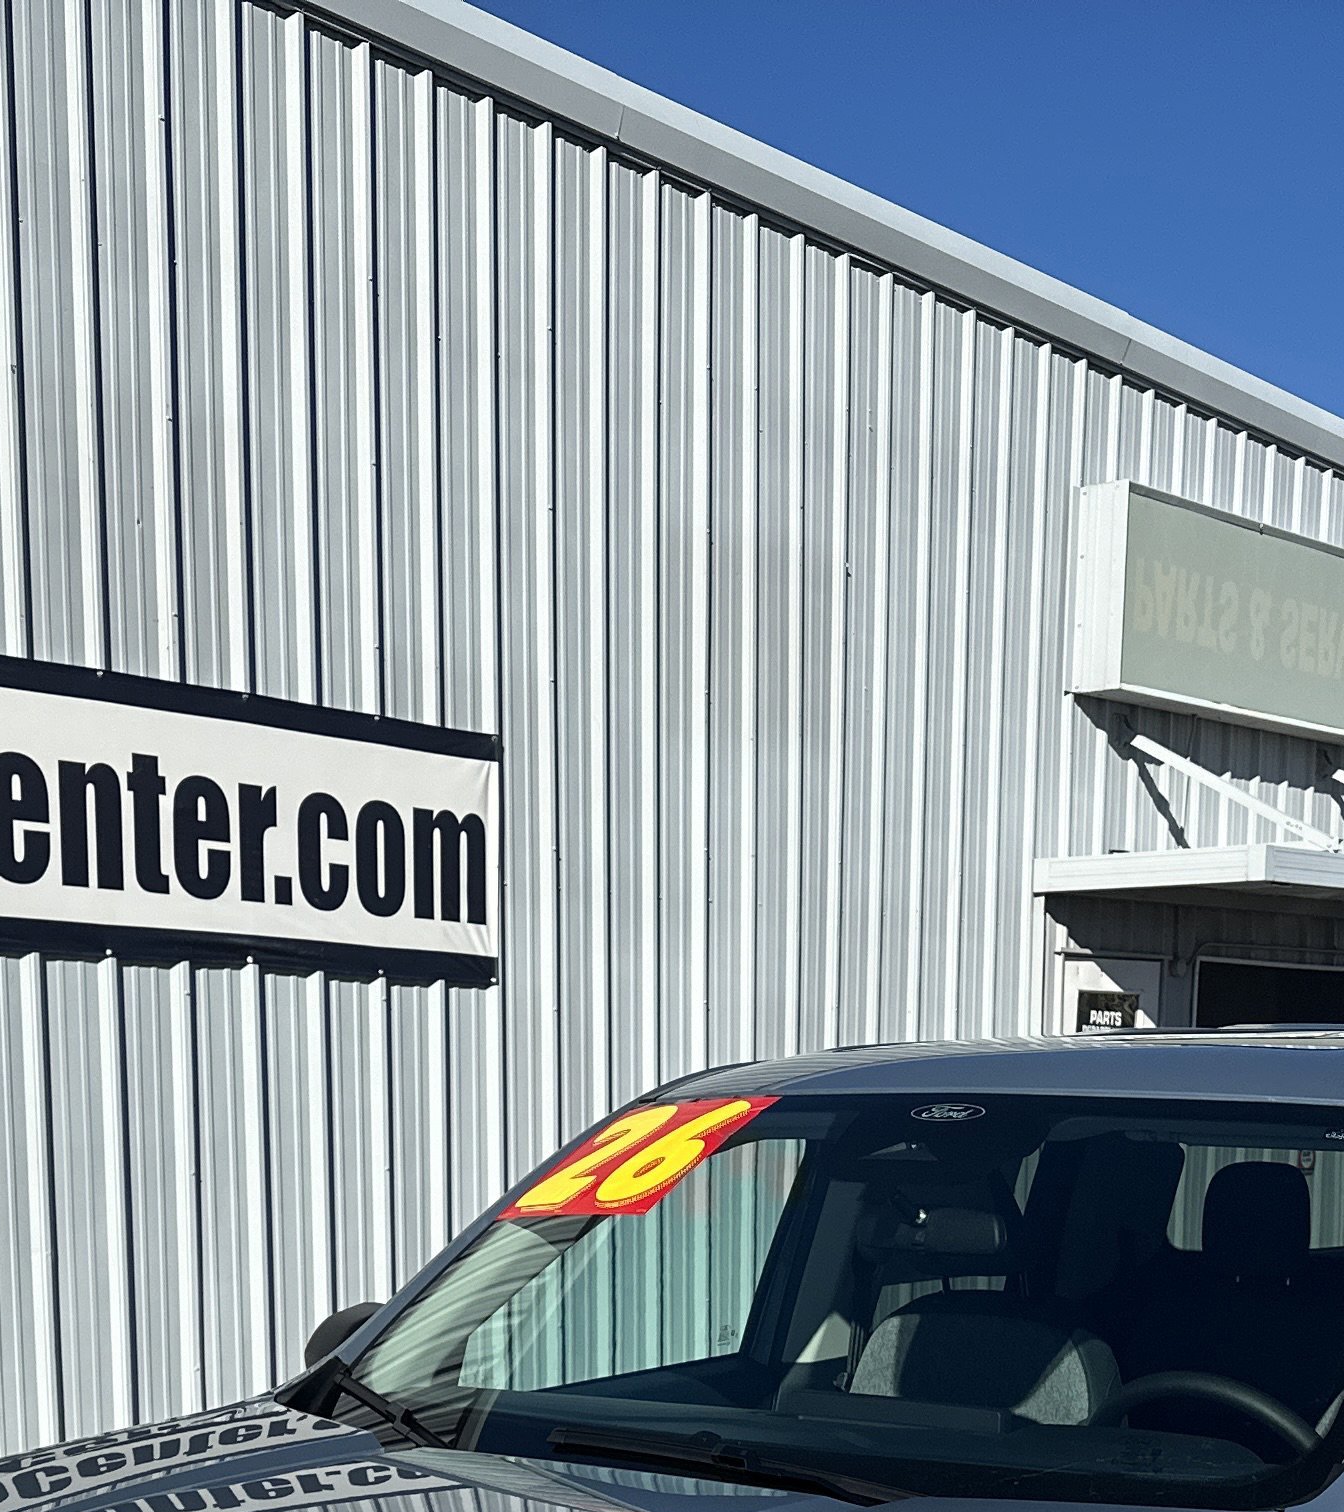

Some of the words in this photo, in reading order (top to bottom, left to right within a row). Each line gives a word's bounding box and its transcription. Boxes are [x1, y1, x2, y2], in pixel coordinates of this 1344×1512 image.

[1089, 1009, 1122, 1027] PARTS
[921, 1104, 975, 1119] Ford
[515, 1099, 752, 1210] 26
